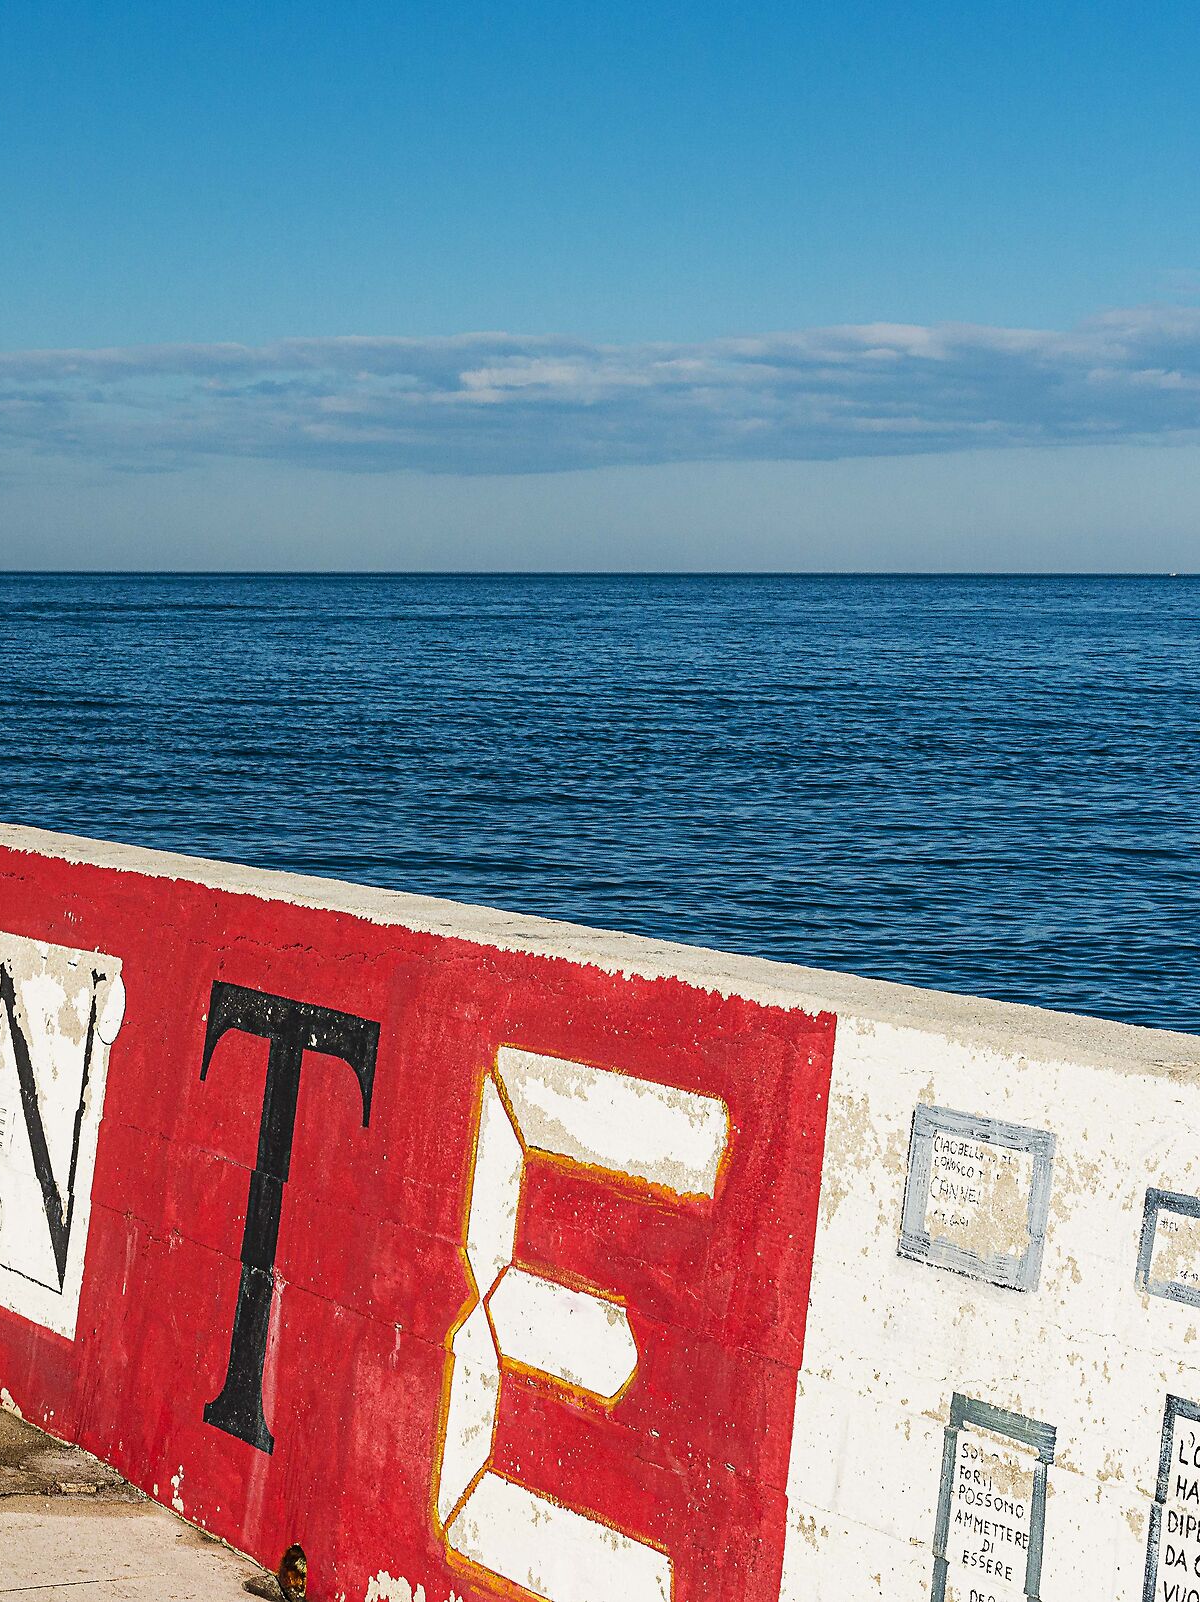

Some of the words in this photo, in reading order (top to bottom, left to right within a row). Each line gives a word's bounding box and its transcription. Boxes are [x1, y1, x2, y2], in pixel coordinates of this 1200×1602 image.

[959, 1484, 1024, 1519] POSSONO
[955, 1509, 1029, 1549] AMMETTERE
[980, 1539, 994, 1553] DI
[1164, 1544, 1188, 1572] DA
[962, 1550, 1013, 1581] ESSERE
